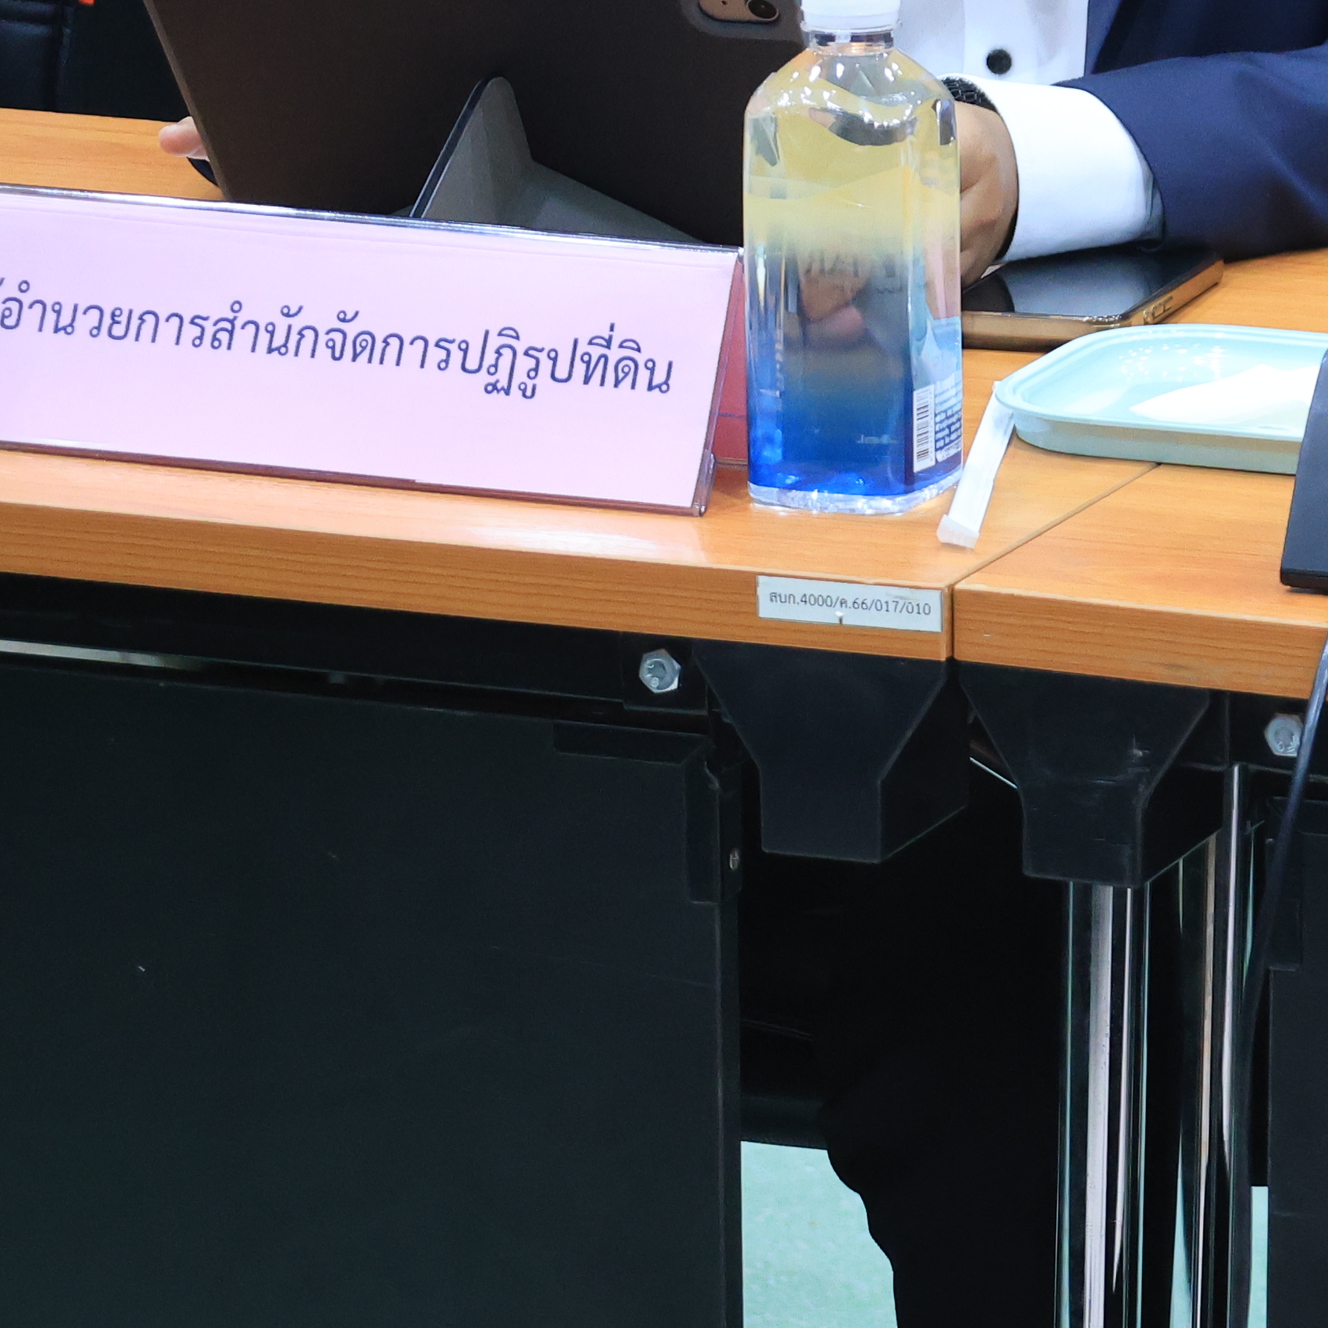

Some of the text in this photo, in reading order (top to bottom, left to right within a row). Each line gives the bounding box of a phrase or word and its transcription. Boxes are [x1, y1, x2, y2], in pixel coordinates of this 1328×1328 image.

[0, 277, 673, 400] อำนวยการสำนักจัดการปฏิรูปที่ดิน
